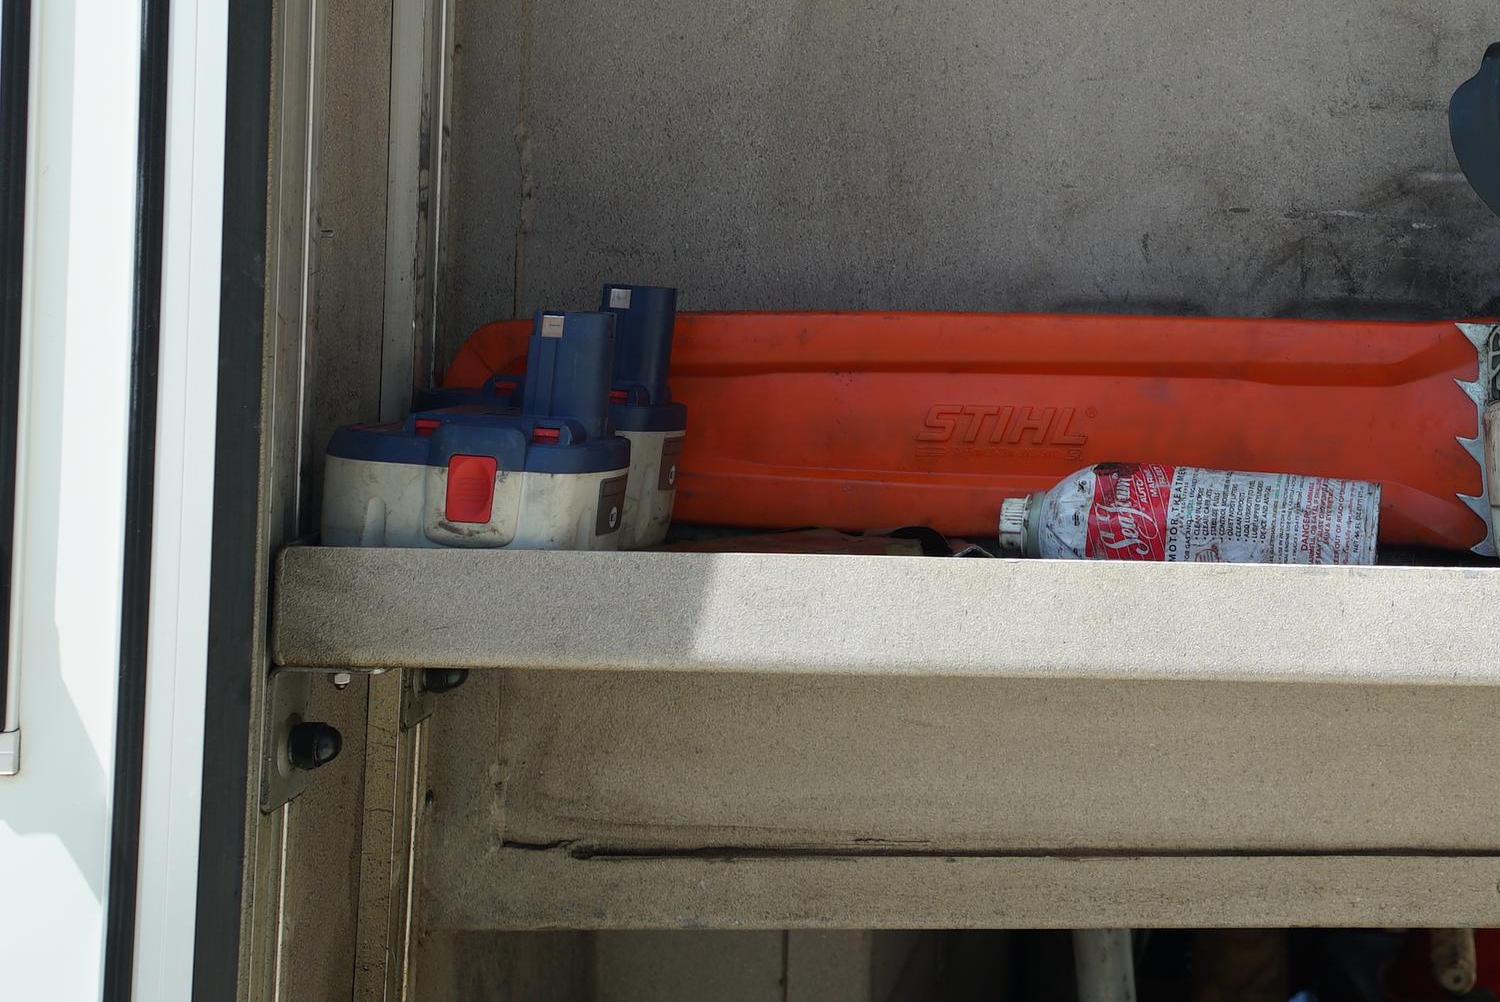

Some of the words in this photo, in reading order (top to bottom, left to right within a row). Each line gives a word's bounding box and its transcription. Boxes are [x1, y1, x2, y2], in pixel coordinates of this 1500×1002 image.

[915, 404, 1088, 446] STIHL
[1135, 479, 1148, 503] AUTO
[1172, 468, 1186, 511] TREATMEN
[1169, 519, 1178, 561] MOTOR
